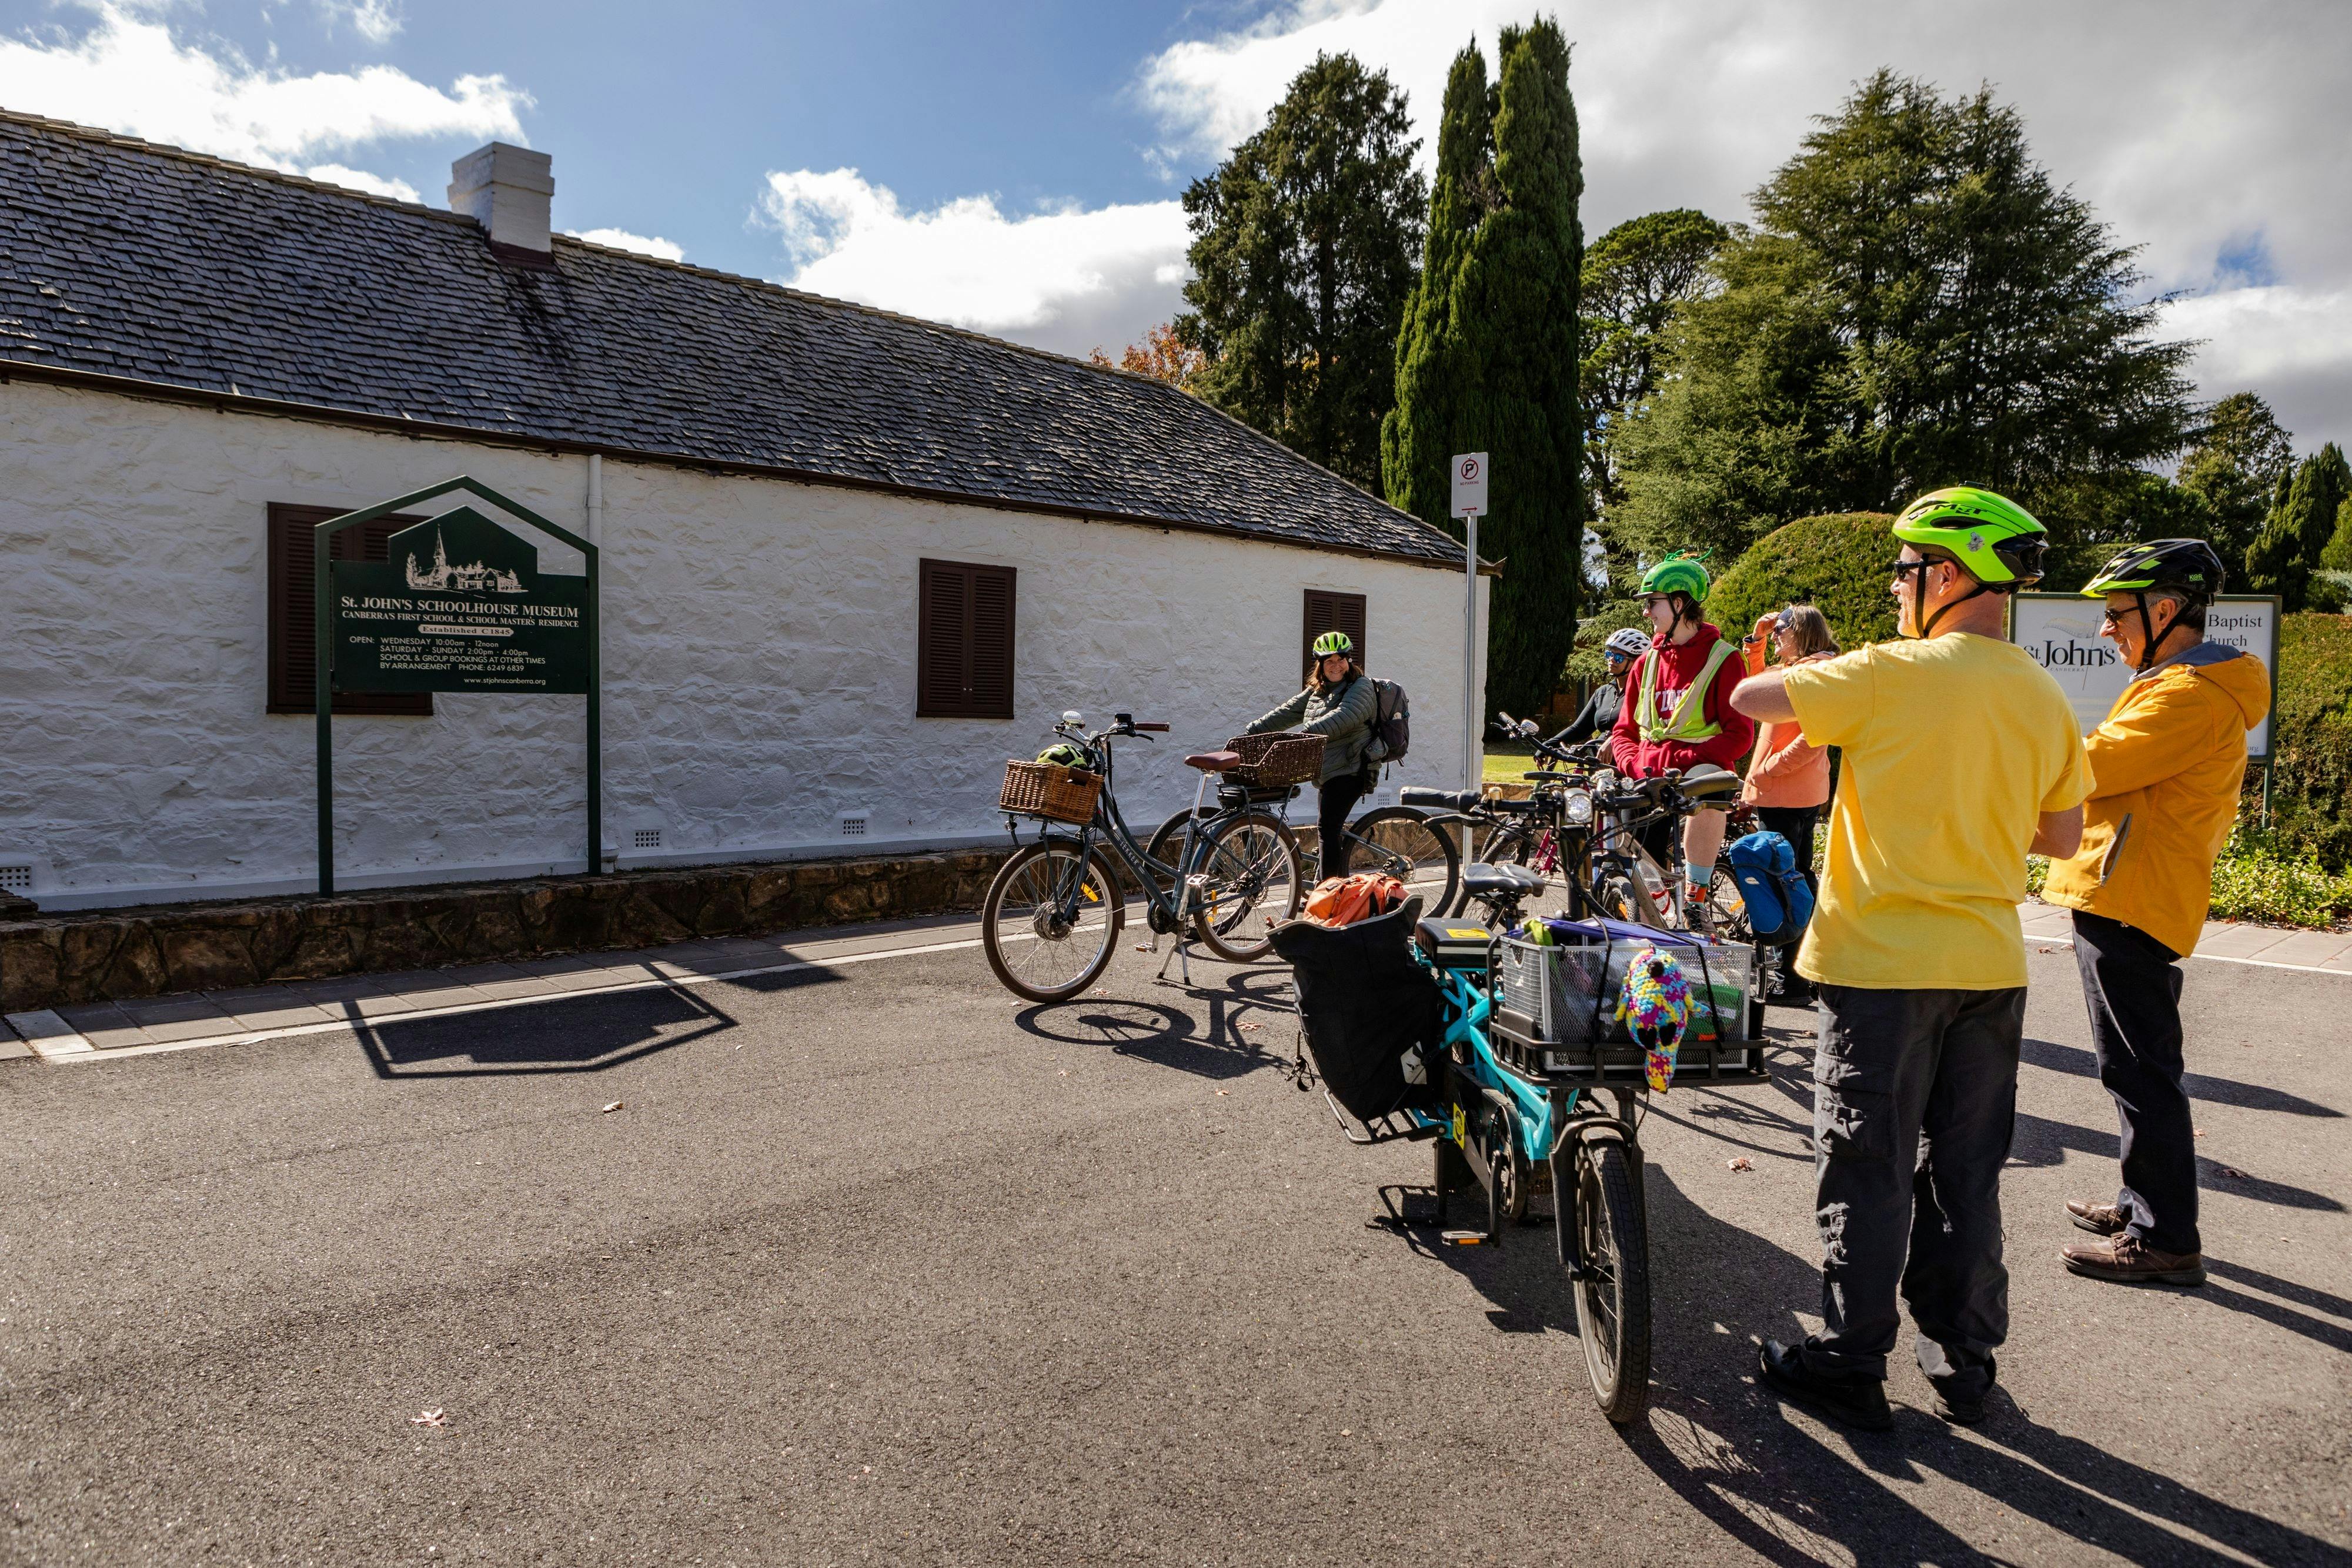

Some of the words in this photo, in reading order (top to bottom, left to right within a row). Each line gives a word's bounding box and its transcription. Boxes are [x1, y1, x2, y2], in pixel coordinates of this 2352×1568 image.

[341, 596, 358, 608] St.
[362, 597, 413, 611] JOHN'S
[417, 600, 519, 615] SCHOOLHOUSE
[523, 605, 579, 618] MUSEUM
[342, 610, 396, 620] CANBERRA'S
[397, 613, 422, 621] FIRST
[423, 614, 456, 623] SCHOOL
[466, 616, 499, 624] SCHOOL
[500, 617, 536, 626] MASTER'S
[539, 619, 580, 628] RESIDENCE
[2208, 614, 2263, 631] Baptist
[422, 626, 477, 634] Established
[436, 638, 465, 647] 10:00am
[2206, 634, 2247, 646] hurch
[380, 645, 422, 653] SATURDAY
[467, 648, 494, 657] 2:00pm
[502, 649, 529, 657] 4:00pm
[2040, 639, 2116, 668] John's
[422, 654, 449, 663] GROUP
[391, 662, 452, 670] ARRANGEMENT
[458, 663, 486, 671] PHONE:
[463, 677, 546, 686] www.stjohnscanberra.org
[1120, 841, 1139, 865] LEKKER
